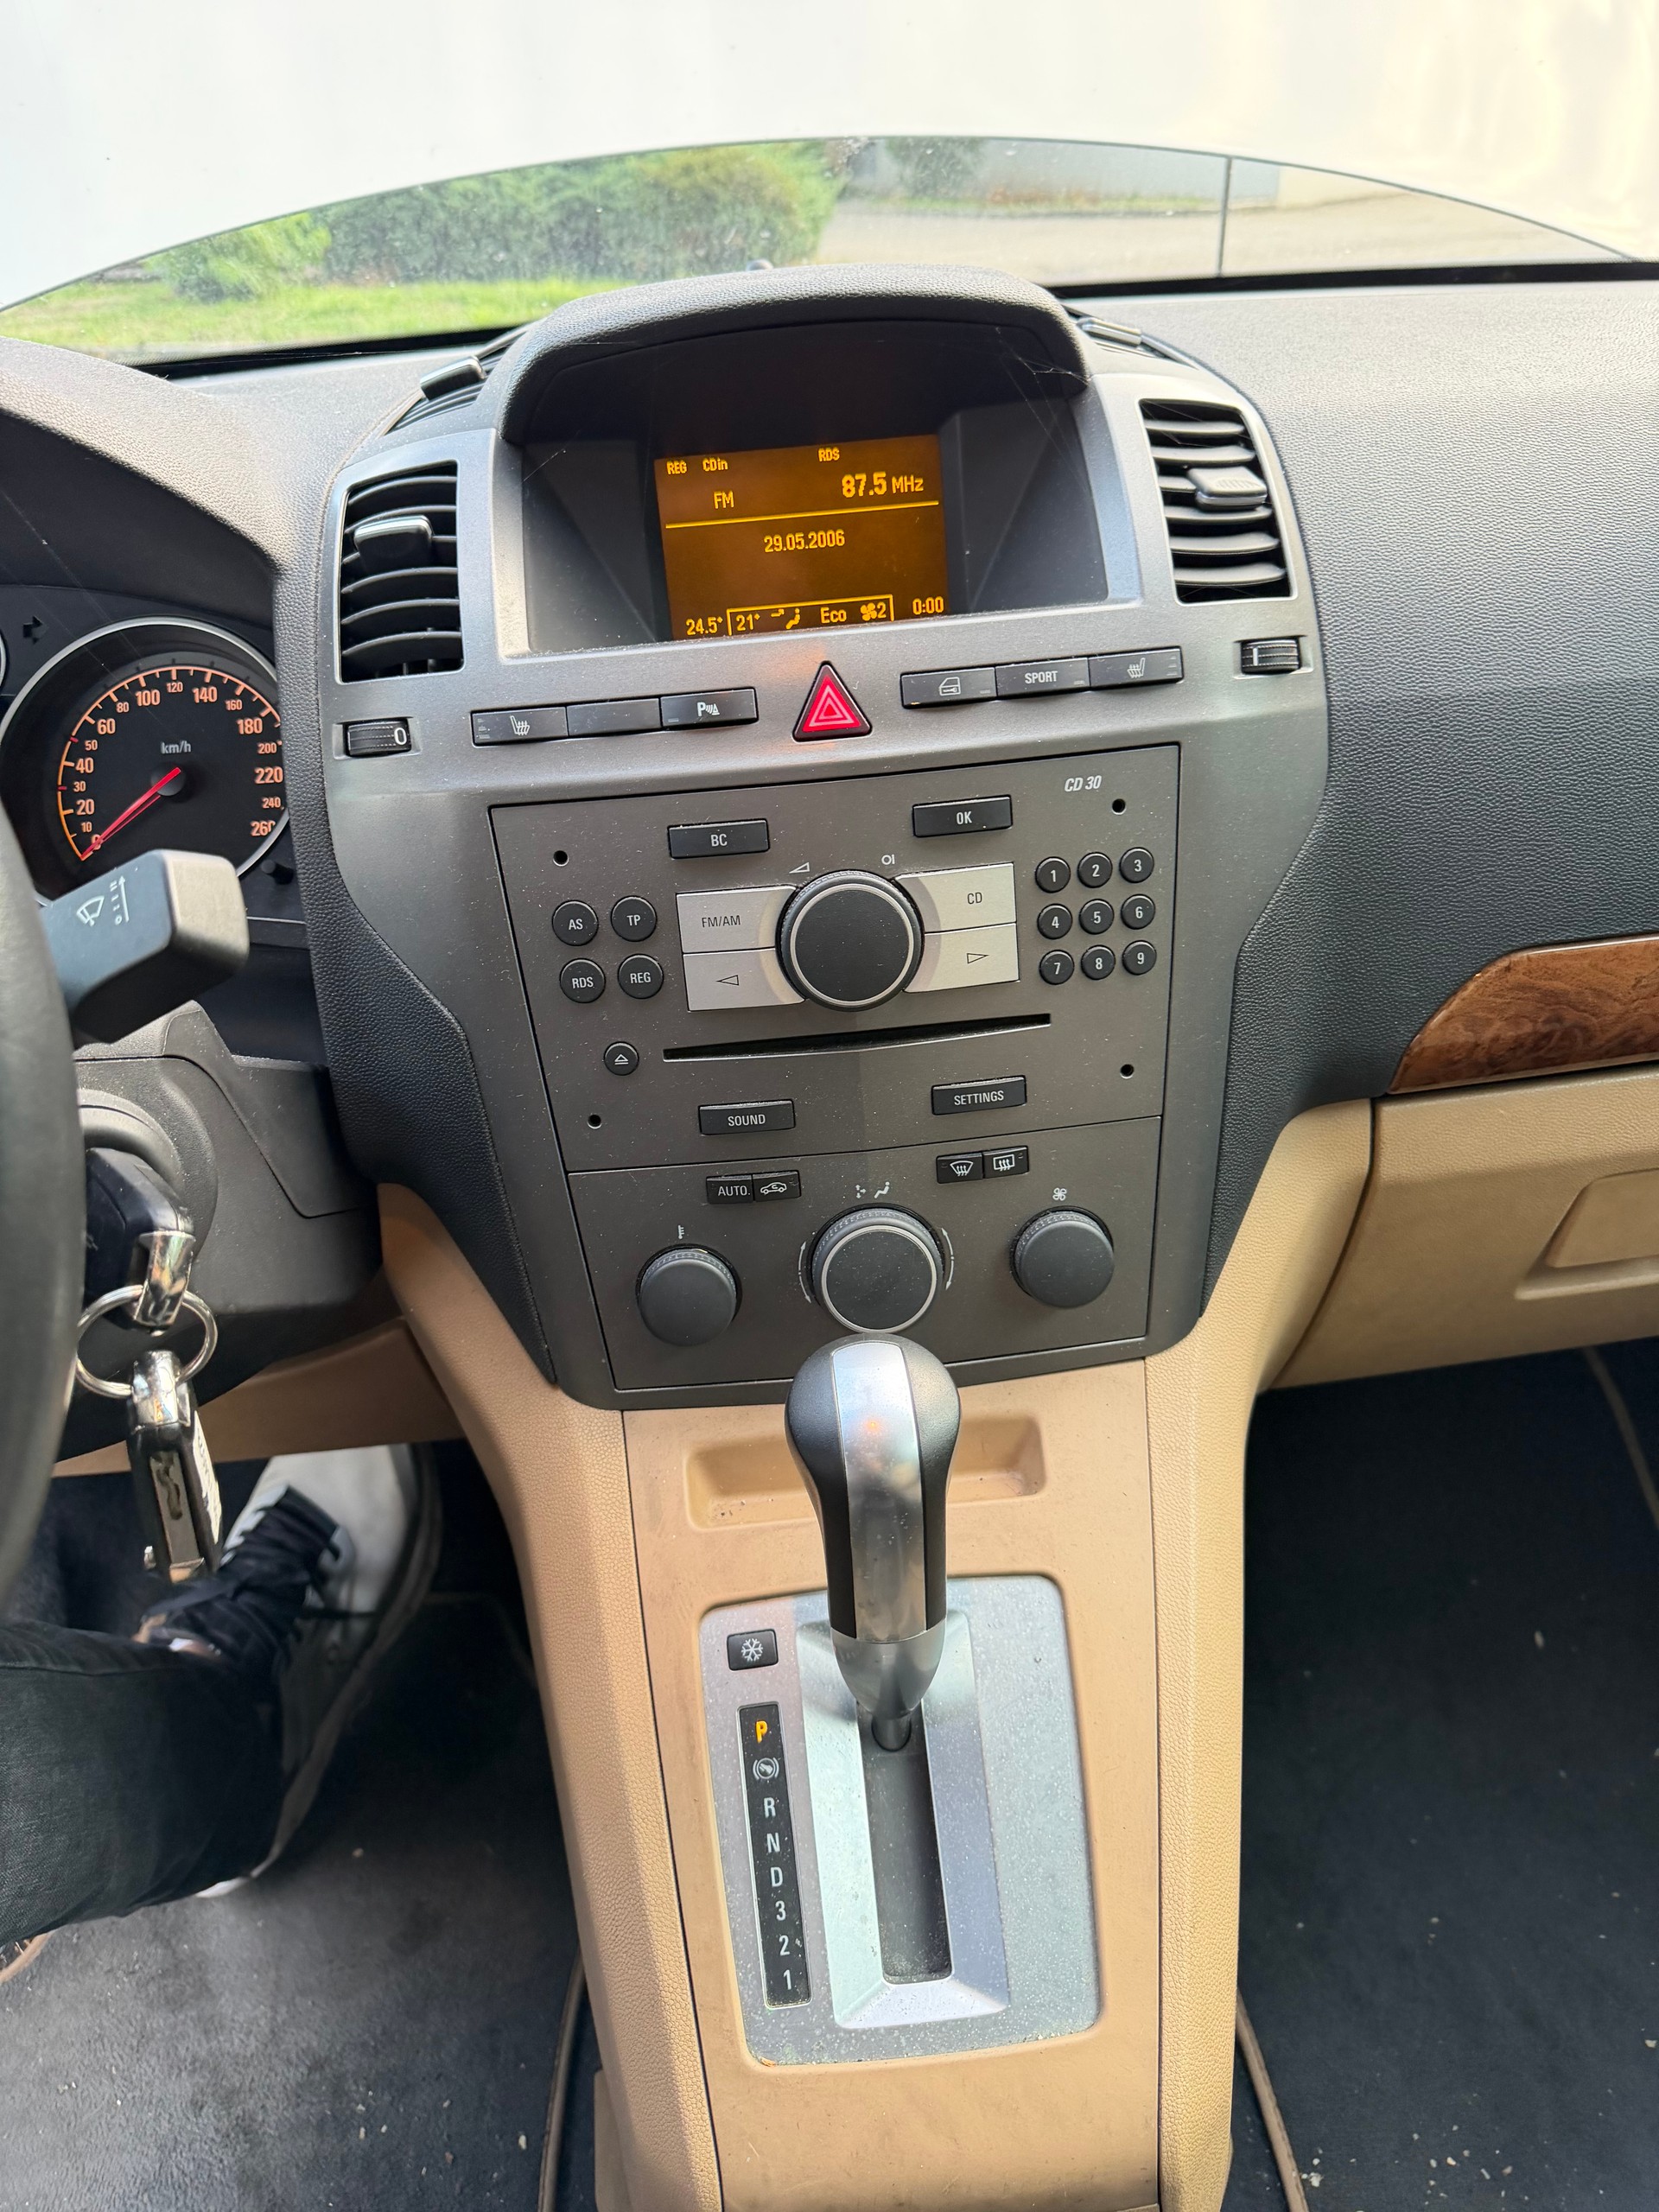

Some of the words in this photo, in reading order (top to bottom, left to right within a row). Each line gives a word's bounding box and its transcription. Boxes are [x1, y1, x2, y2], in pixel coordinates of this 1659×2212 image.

[818, 447, 840, 462] RDS
[666, 461, 688, 474] REG
[702, 457, 728, 472] CDin
[841, 472, 887, 498] 87.5
[892, 476, 925, 493] MHz
[714, 491, 734, 509] FM
[764, 529, 845, 552] 29.05.2006
[876, 601, 887, 619] 2
[912, 596, 944, 615] 0:00
[736, 613, 760, 631] 21°
[821, 607, 847, 624] Eco
[686, 616, 723, 635] 24.5°
[1025, 671, 1058, 684] SPORT
[167, 682, 183, 692] 120
[135, 690, 161, 707] 100
[193, 687, 218, 702] 140
[116, 701, 130, 713] 80
[225, 699, 243, 711] 160
[97, 719, 116, 734] 60
[236, 718, 263, 734] 180
[84, 740, 98, 752] 50
[161, 741, 192, 754] km/h
[257, 742, 277, 754] 200
[75, 757, 94, 774] 40
[254, 766, 283, 784] 220
[73, 780, 86, 792] 30
[1064, 778, 1082, 792] CD
[1084, 775, 1103, 791] 30
[76, 798, 95, 815] 20
[262, 797, 281, 809] 240
[956, 810, 973, 825] OK
[81, 821, 92, 833] 10
[710, 834, 728, 848] BC
[1091, 864, 1101, 878] 2
[1134, 859, 1142, 873] 3
[1050, 869, 1057, 883] 1
[967, 892, 982, 905] CD
[1092, 911, 1102, 925] 5
[1135, 906, 1143, 919] 6
[568, 918, 583, 931] AS
[626, 914, 641, 926] TP
[702, 915, 741, 928] FM/AM
[1052, 916, 1060, 930] 4
[1094, 957, 1103, 971] 8
[1136, 952, 1145, 965] 9
[1053, 963, 1061, 976] 7
[571, 976, 594, 989] RDS
[630, 971, 652, 984] REG
[954, 1090, 1004, 1105] SETTINGS
[728, 1114, 766, 1127] SOUND
[755, 1721, 768, 1742] P
[764, 1798, 776, 1816] R
[766, 1833, 780, 1853] N
[770, 1866, 784, 1887] D
[775, 1901, 787, 1922] 3
[779, 1936, 791, 1955] 2
[783, 1970, 792, 1990] 1
